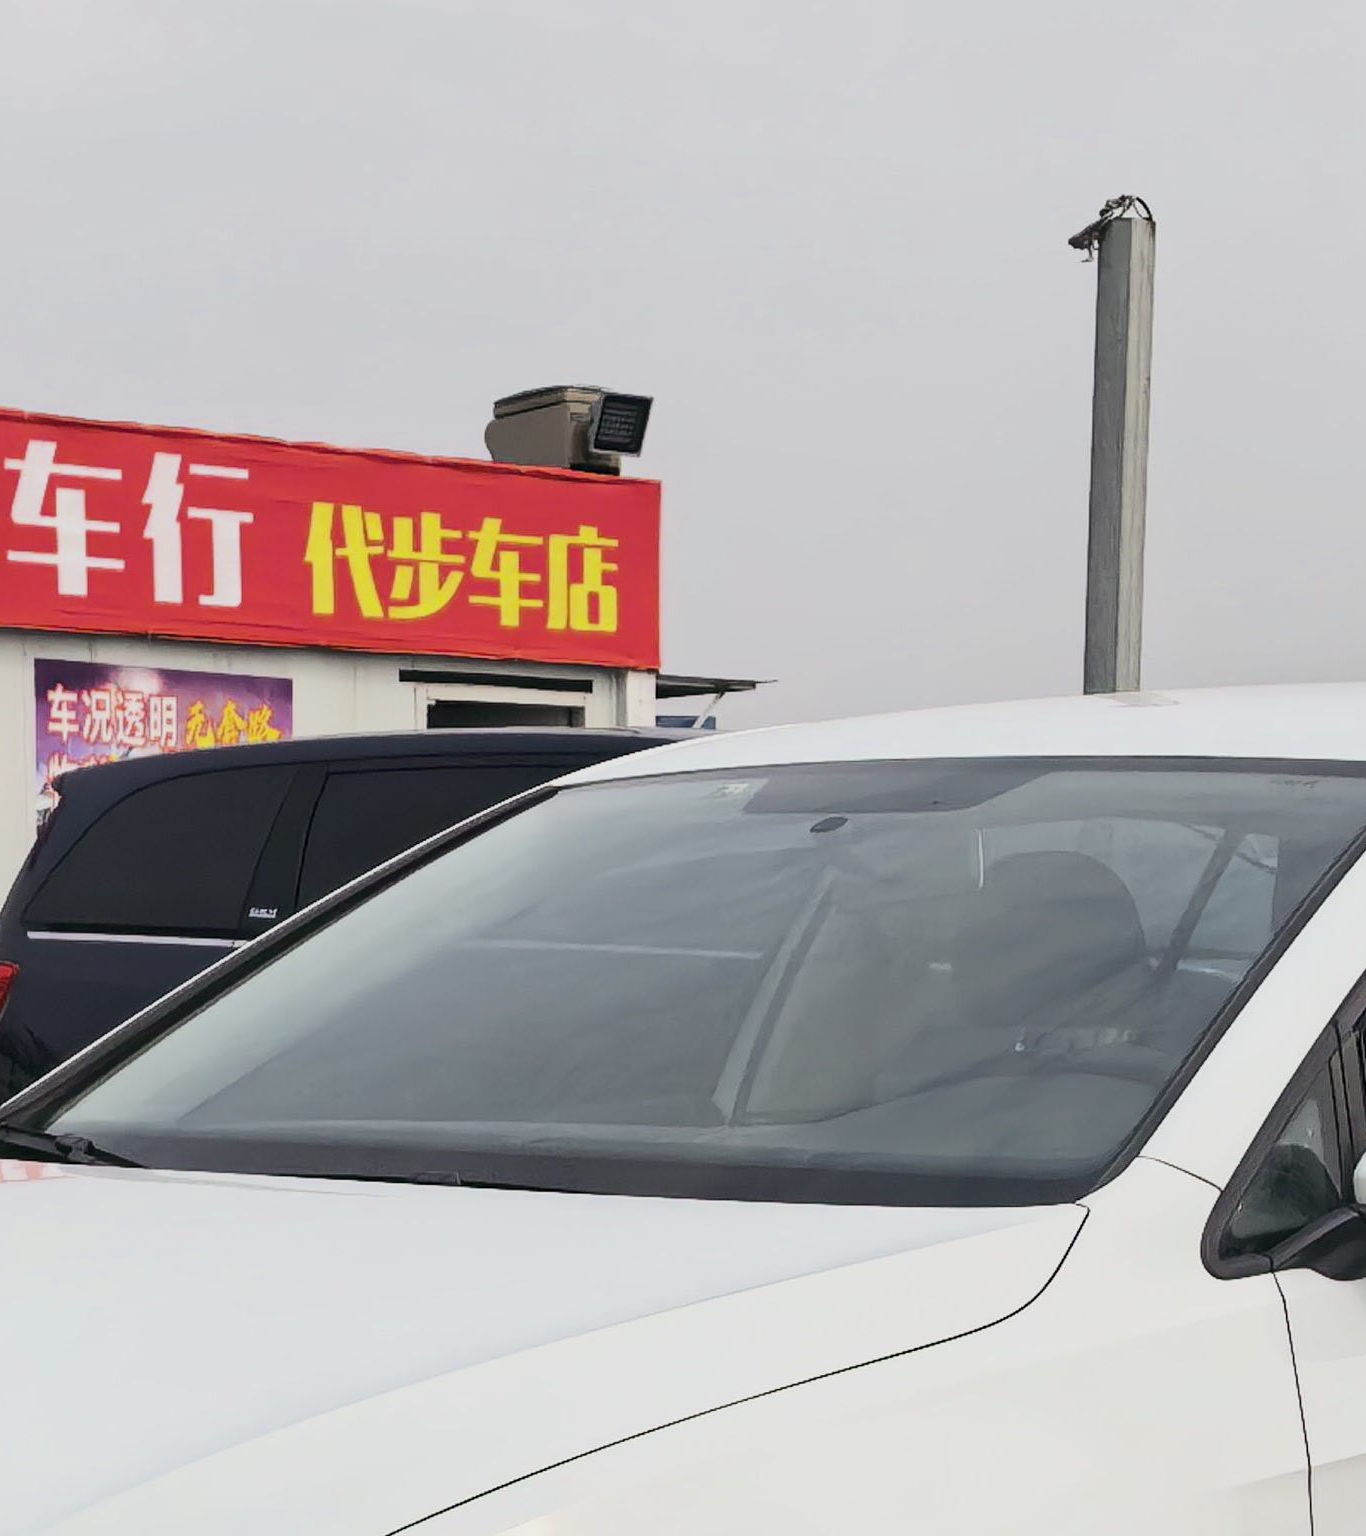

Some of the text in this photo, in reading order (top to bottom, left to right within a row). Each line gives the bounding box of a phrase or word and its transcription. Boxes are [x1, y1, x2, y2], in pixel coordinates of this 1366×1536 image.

[304, 500, 620, 633] 代步车店
[46, 683, 179, 749] 车况透明
